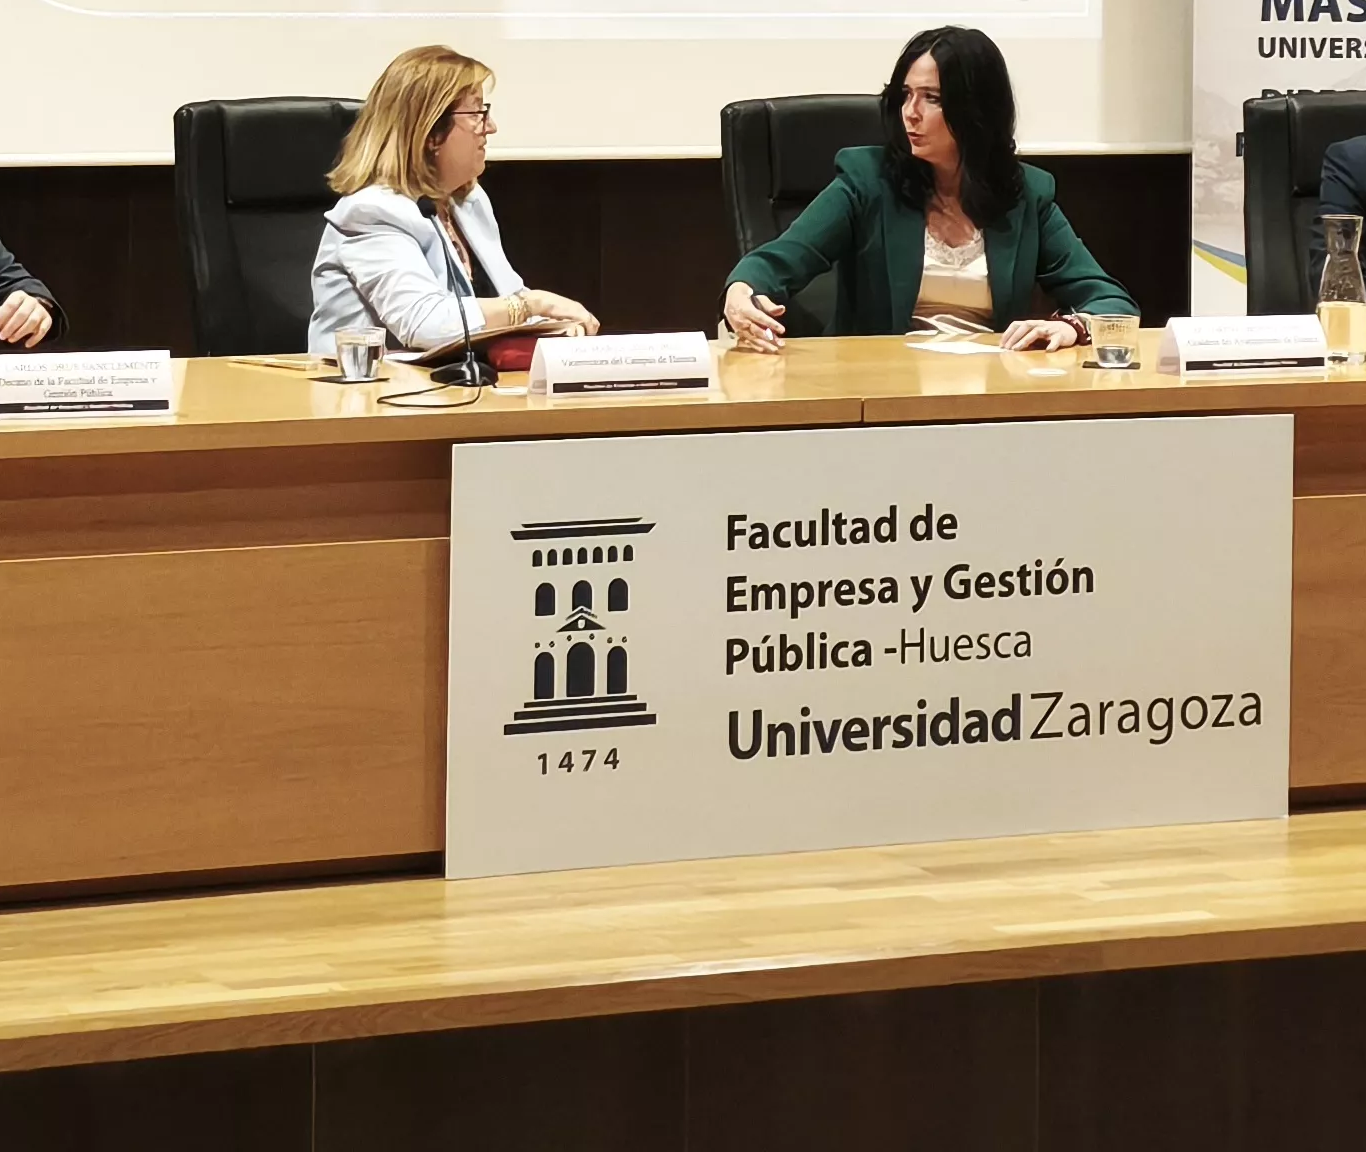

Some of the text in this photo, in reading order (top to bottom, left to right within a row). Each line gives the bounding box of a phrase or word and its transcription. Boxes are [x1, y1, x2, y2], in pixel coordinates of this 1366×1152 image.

[726, 503, 958, 551] Facultad de
[726, 557, 1095, 620] Empresa y Gestión
[724, 633, 873, 676] Pública
[727, 690, 1263, 761] Universidad Zaragoza
[536, 747, 621, 776] 1474
